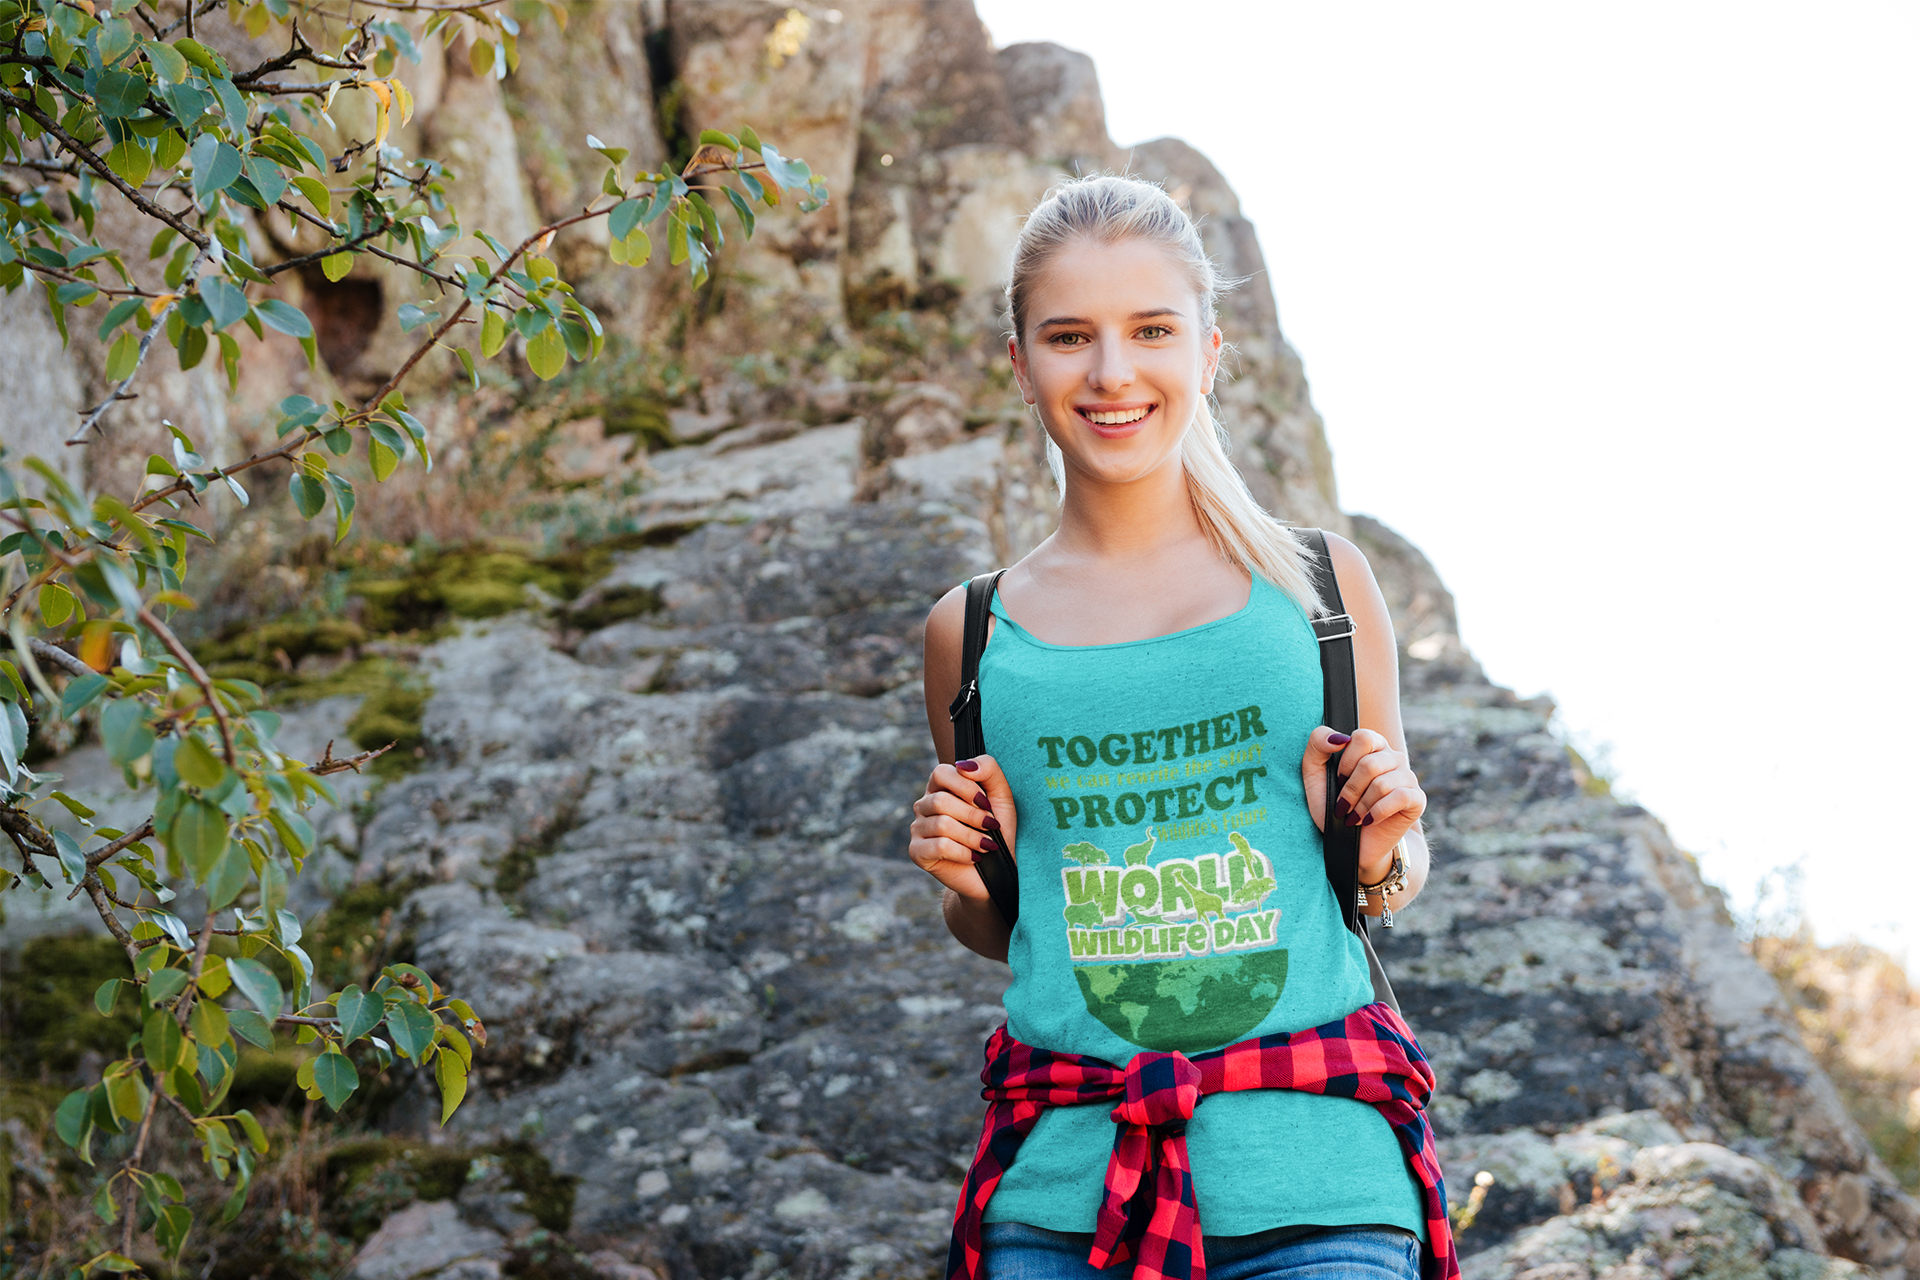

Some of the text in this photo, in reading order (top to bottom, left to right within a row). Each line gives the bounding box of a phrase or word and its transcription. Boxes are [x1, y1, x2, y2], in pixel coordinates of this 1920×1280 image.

[1037, 705, 1267, 768] TOGETHER
[1044, 743, 1266, 789] we can rewrite the story
[1049, 766, 1267, 829] PROTECT
[1156, 806, 1268, 843] Wildlife's Future
[1062, 849, 1275, 922] WORLD
[1211, 910, 1280, 952] DAY
